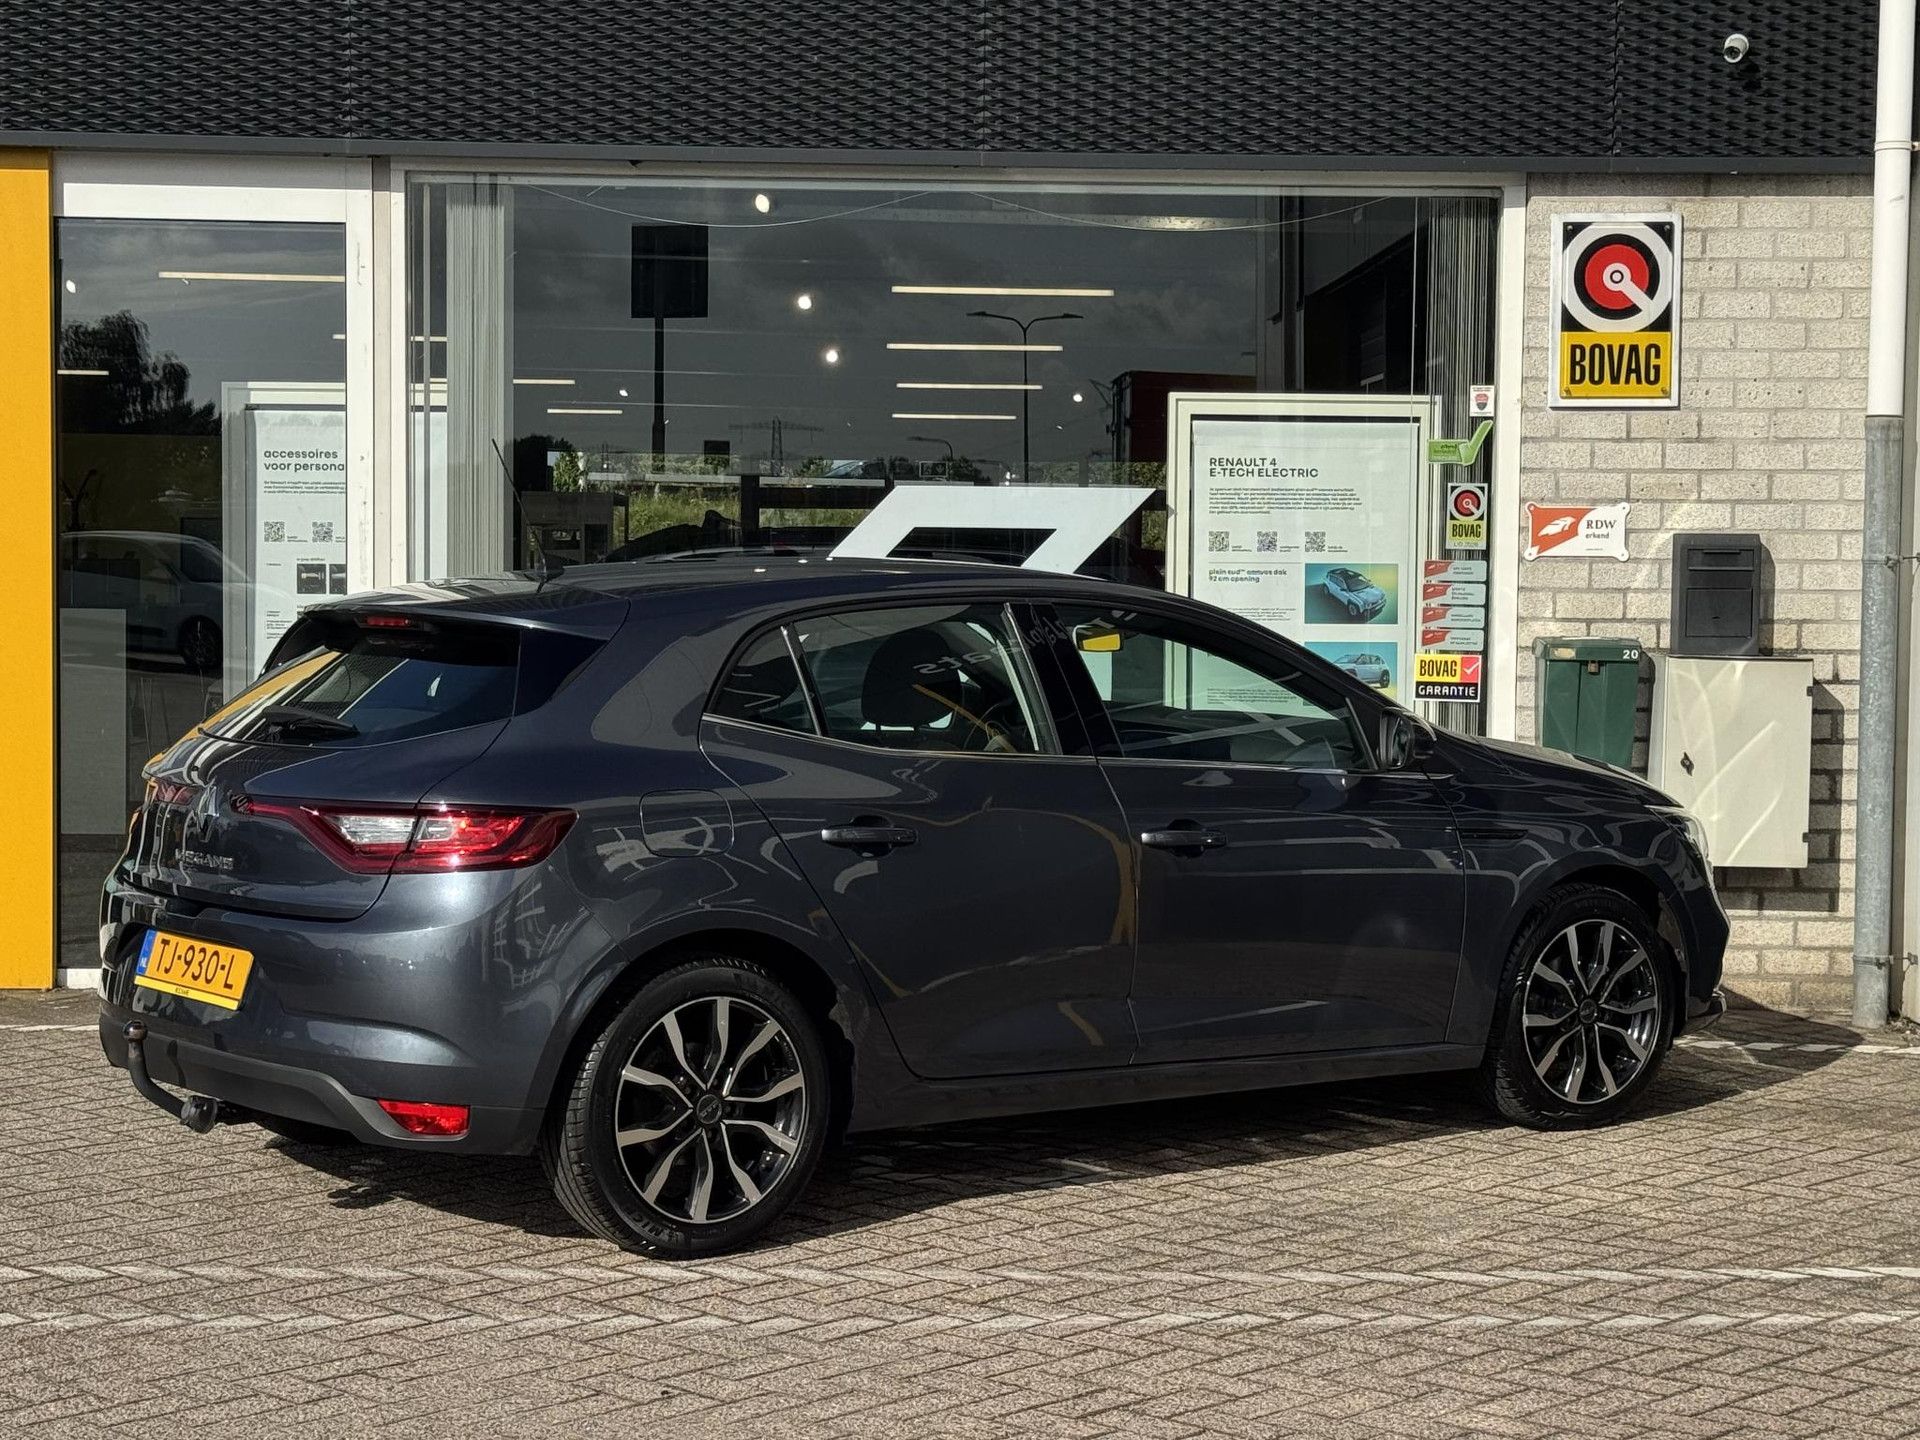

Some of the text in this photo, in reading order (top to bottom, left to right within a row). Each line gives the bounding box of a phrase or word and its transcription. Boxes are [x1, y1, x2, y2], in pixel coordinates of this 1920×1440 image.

[1569, 343, 1661, 386] BOVAG
[263, 448, 338, 459] accessoires
[1209, 457, 1277, 467] RENAULT 4
[263, 463, 345, 473] voor persona
[1209, 468, 1319, 478] E-TECH ELECTRIC
[1586, 519, 1617, 530] RDW
[1452, 523, 1482, 538] BOVAG
[1585, 531, 1610, 539] erkend
[1273, 568, 1287, 576] dak
[1622, 649, 1639, 660] 20
[1419, 659, 1458, 677] BOVAG
[1418, 685, 1476, 697] GARANTIE
[156, 938, 235, 991] TJ-930-L
